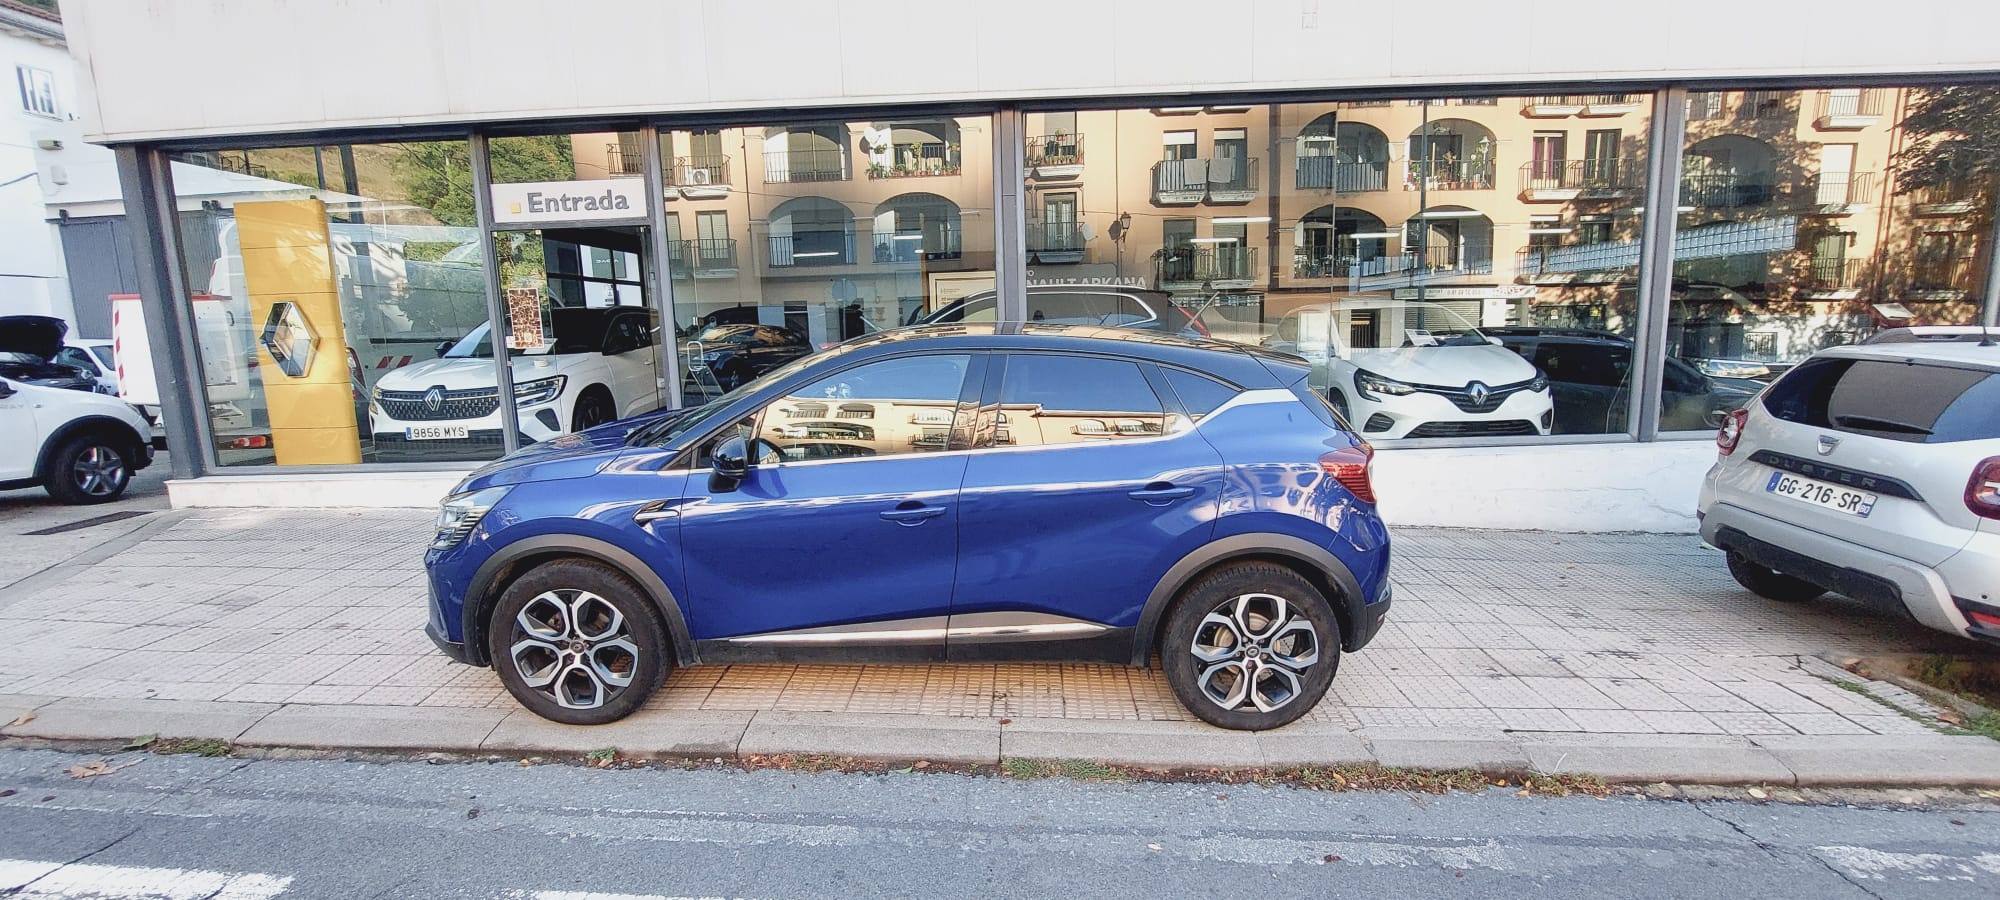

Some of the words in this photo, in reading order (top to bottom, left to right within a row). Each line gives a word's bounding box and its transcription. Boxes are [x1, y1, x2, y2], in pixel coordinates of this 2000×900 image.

[527, 189, 630, 213] Entrada
[413, 428, 441, 438] 9856
[444, 426, 465, 437] MYS
[1769, 457, 1877, 487] DUSTER
[1778, 477, 1862, 511] GG-216-SR
